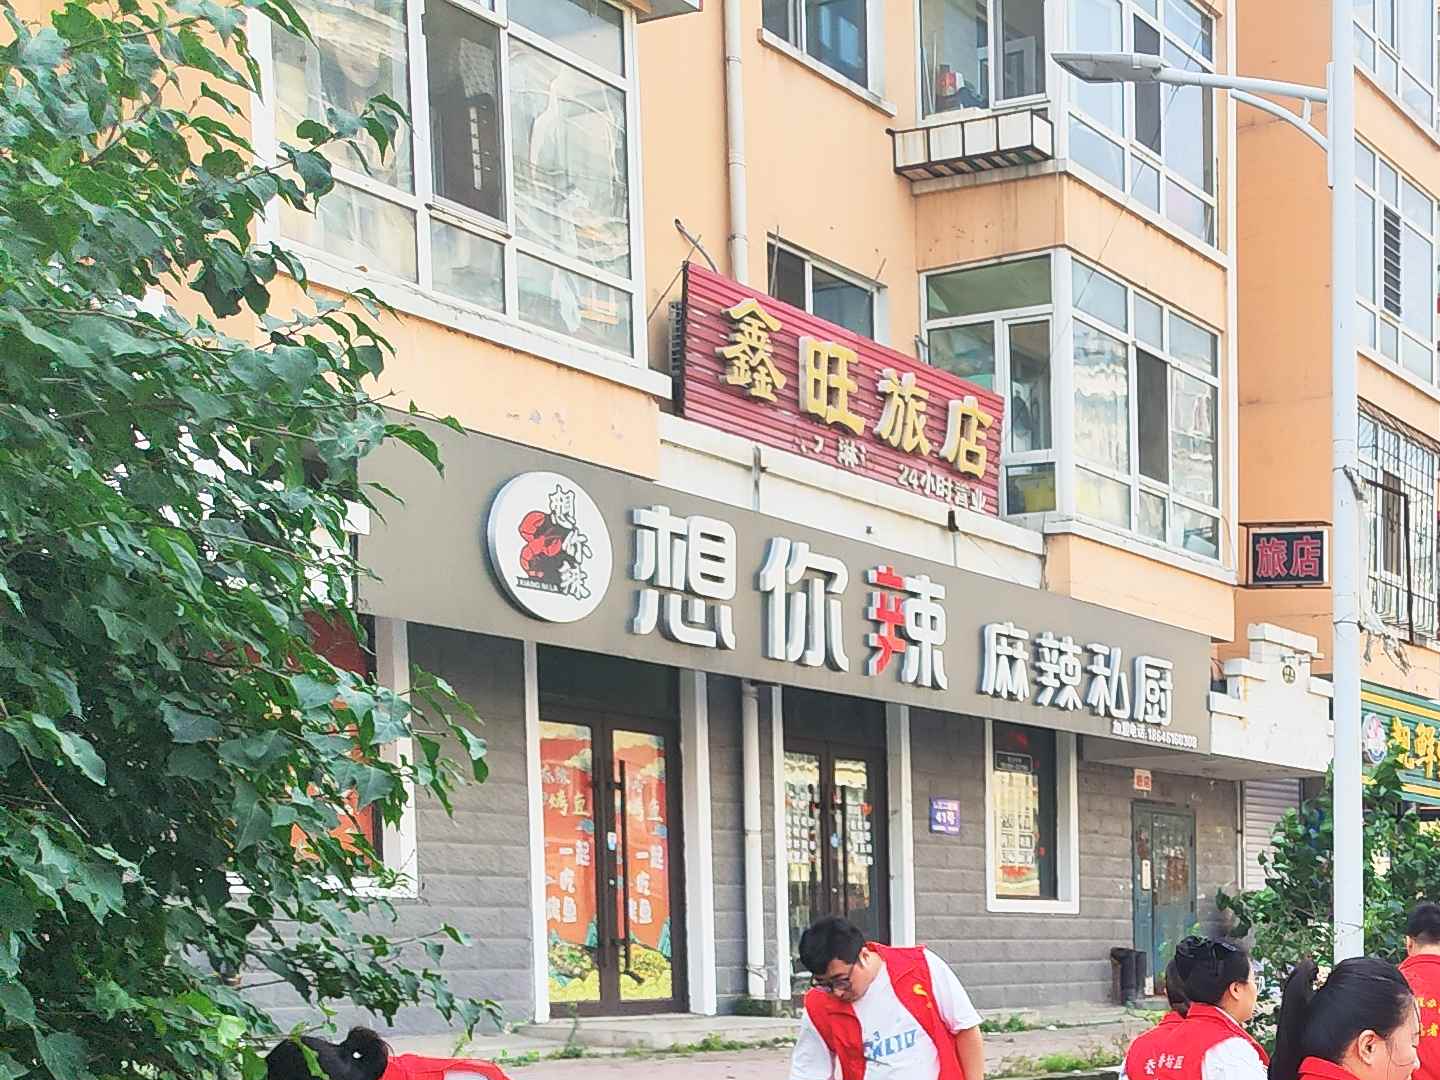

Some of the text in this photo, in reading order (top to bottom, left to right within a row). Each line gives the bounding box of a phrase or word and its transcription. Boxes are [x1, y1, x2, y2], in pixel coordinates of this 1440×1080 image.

[715, 297, 993, 479] 鑫旺旅店
[632, 504, 1174, 727] 想你辣 麻辣私厨
[1255, 535, 1321, 577] 旅店
